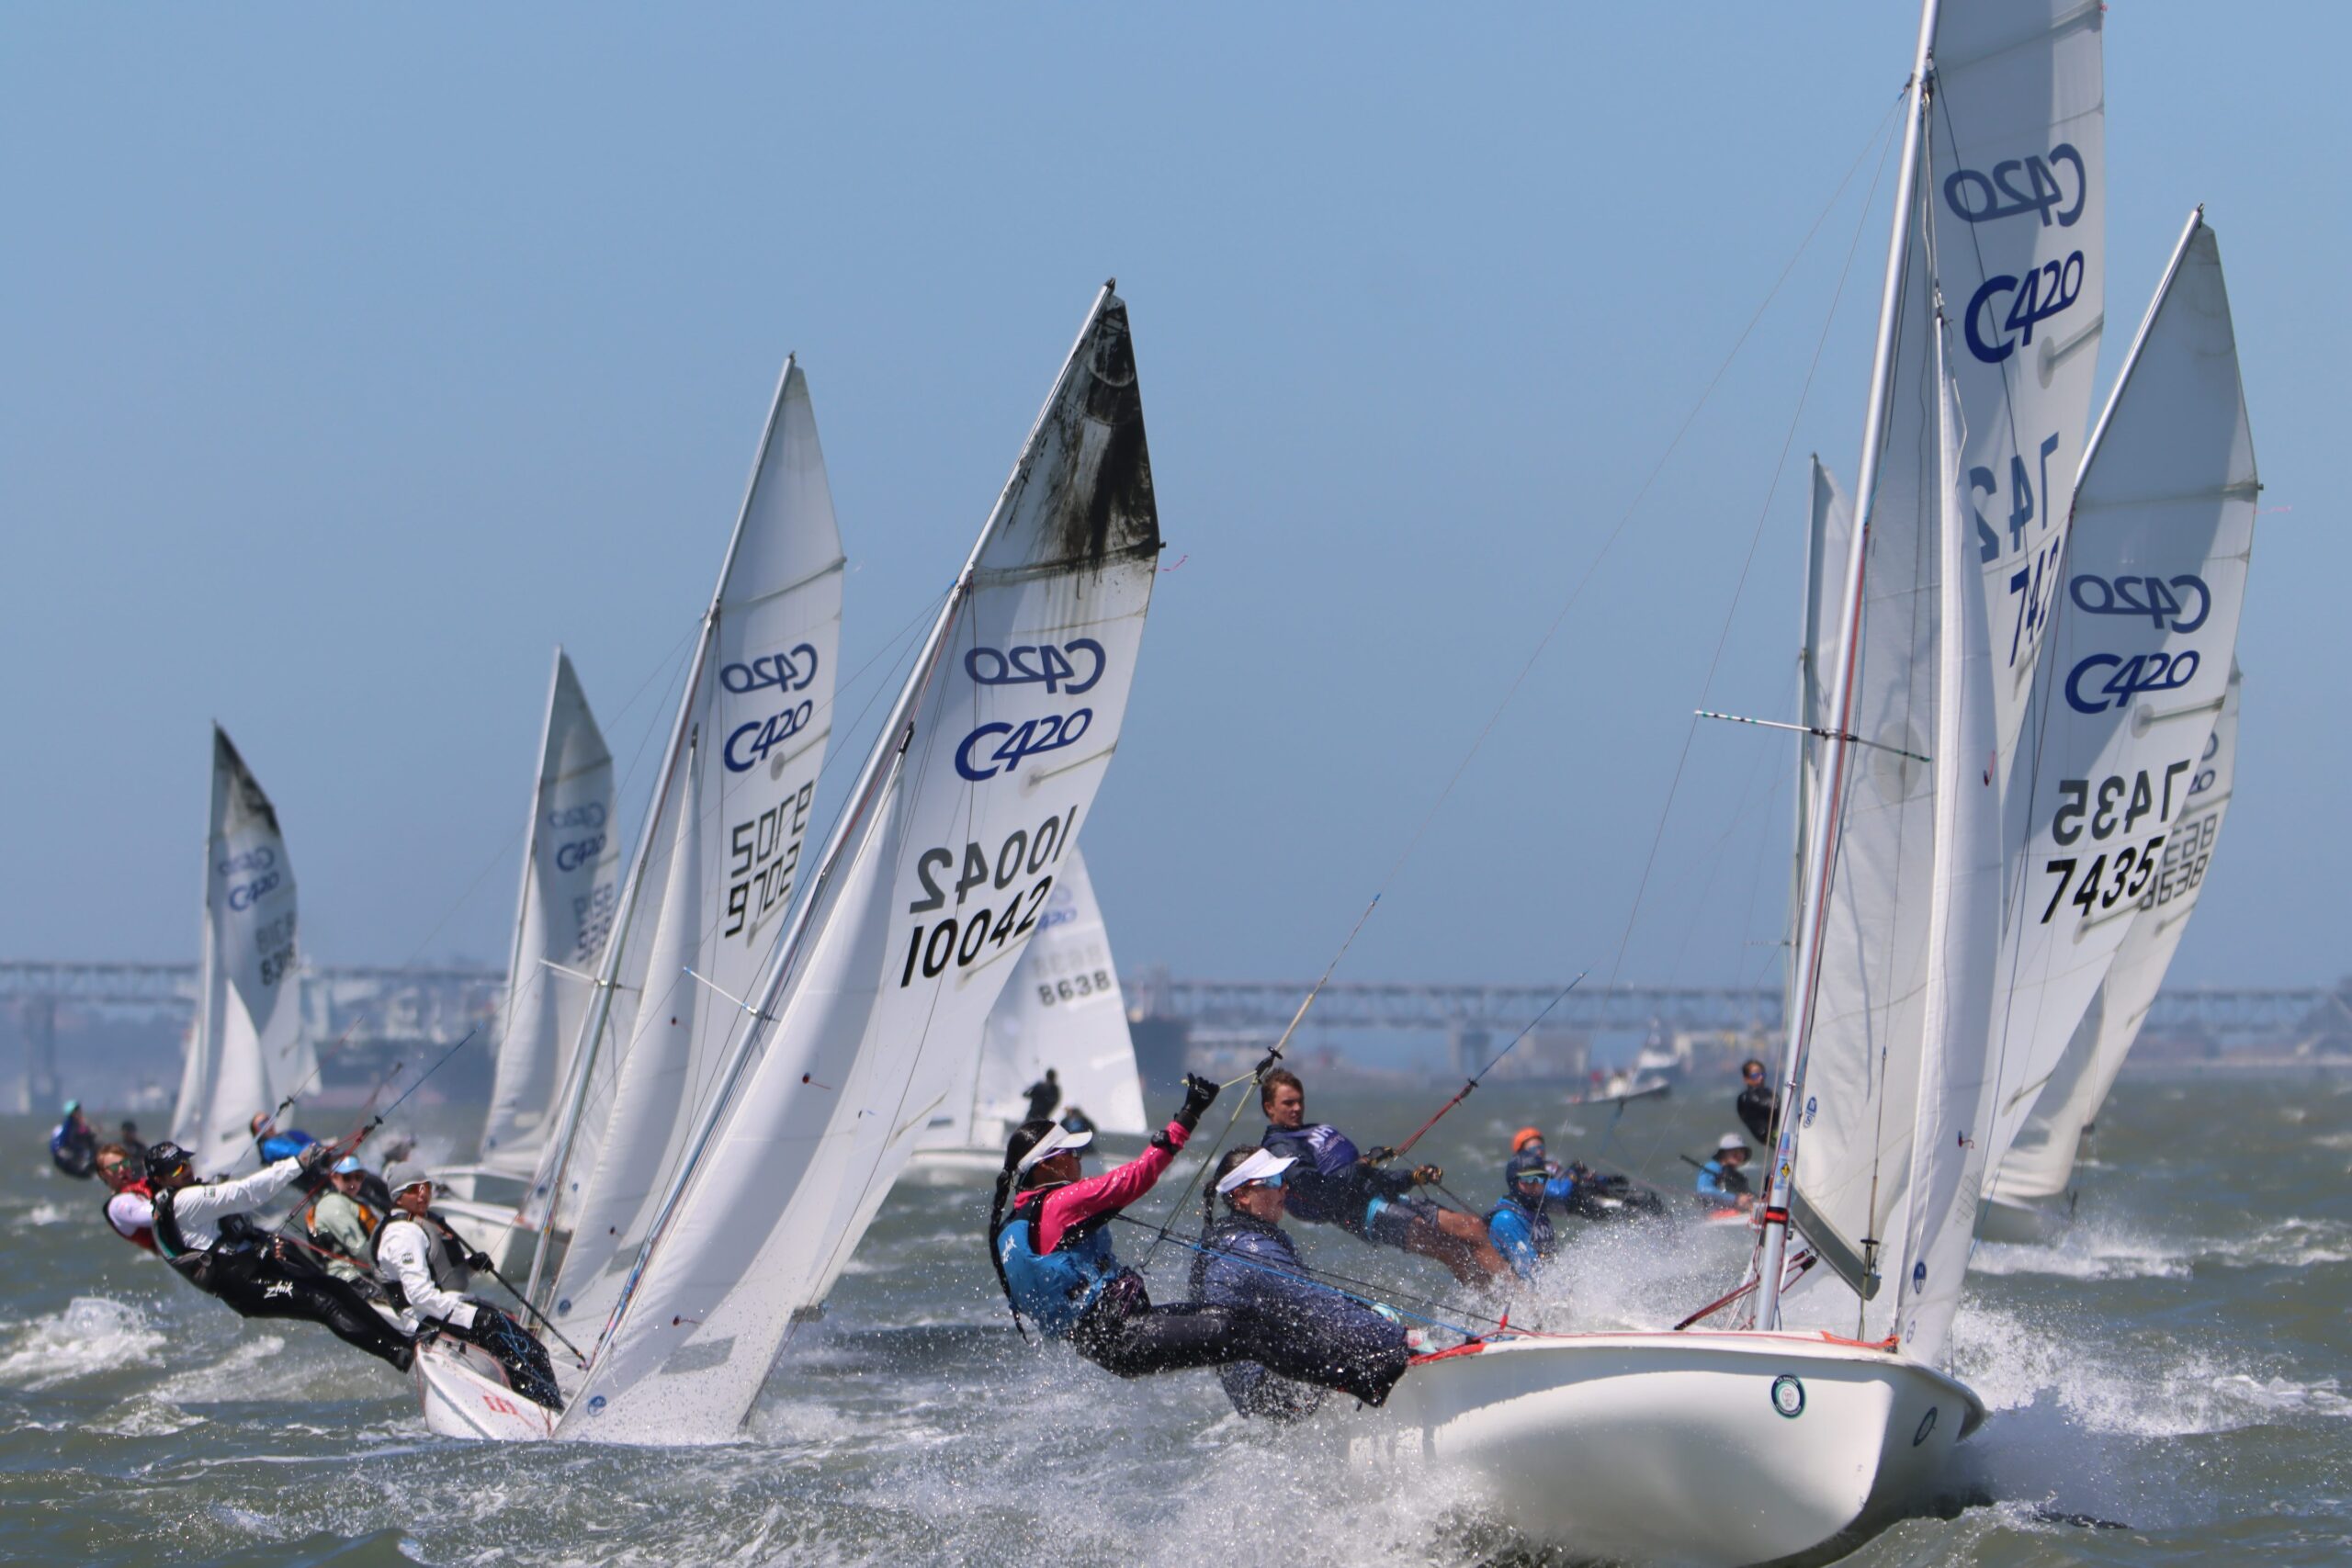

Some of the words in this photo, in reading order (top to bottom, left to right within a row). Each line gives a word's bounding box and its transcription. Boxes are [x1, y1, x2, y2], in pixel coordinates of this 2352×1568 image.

[1964, 250, 2084, 363] C420
[2009, 535, 2060, 669] 742
[2064, 650, 2200, 714] C420
[724, 699, 813, 773] C420
[955, 707, 1093, 782] C420
[725, 840, 801, 939] 9702
[2041, 835, 2165, 924] 7435
[900, 875, 1053, 988] 10042
[1037, 970, 1111, 1007] 8638
[264, 1280, 294, 1300] zhik
